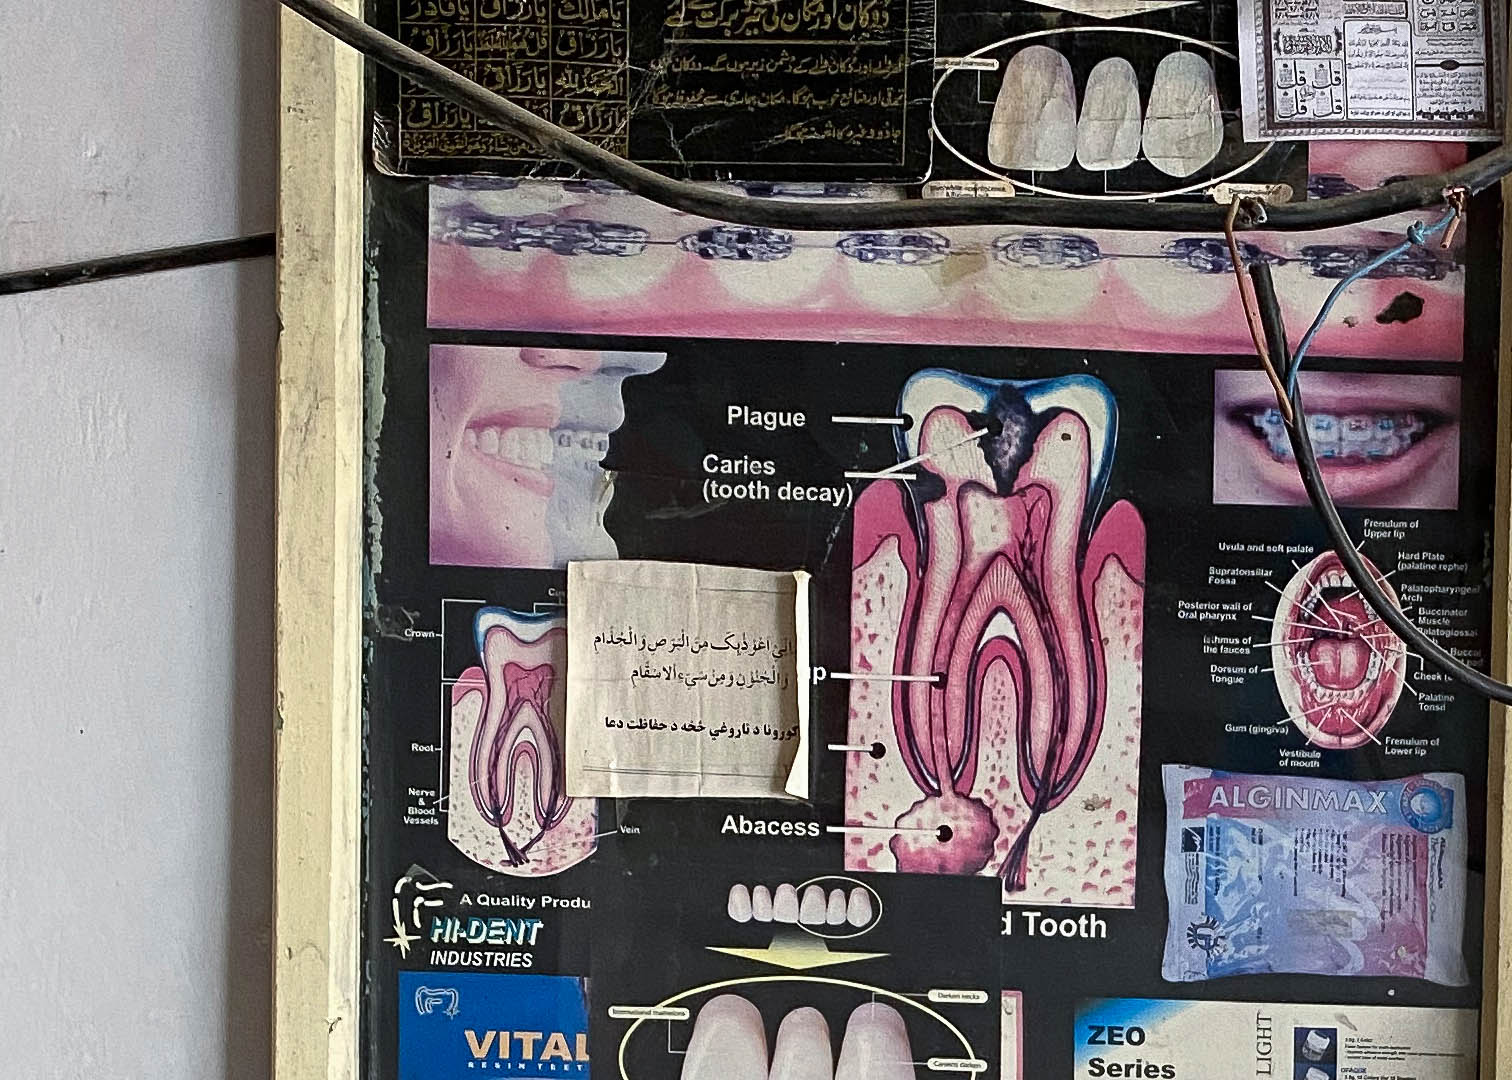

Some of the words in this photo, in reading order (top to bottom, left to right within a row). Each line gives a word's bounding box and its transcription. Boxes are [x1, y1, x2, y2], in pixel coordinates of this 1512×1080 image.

[727, 406, 805, 430] Plague
[703, 454, 775, 475] Caries
[703, 479, 770, 503] (tooth
[778, 482, 853, 507] decay)
[1178, 601, 1219, 611] Posterior
[1178, 611, 1197, 619] Oral
[404, 628, 435, 639] Crown
[1225, 724, 1246, 733] Gum
[1249, 725, 1288, 735] (gingiva)
[1291, 759, 1319, 767] mouth
[1208, 785, 1387, 814] ALGINMAX
[620, 826, 639, 834] Vein
[721, 815, 819, 837] Abacess
[460, 894, 472, 905] A
[477, 894, 536, 910] Quality
[430, 916, 544, 946] HI-DENT
[1023, 912, 1106, 939] Tooth
[430, 950, 532, 968] INDUSTRIES
[464, 1030, 589, 1061] VITAL
[1087, 1025, 1145, 1046] ZEO
[1256, 1013, 1272, 1076] LIGHT
[1088, 1057, 1176, 1080] Series
